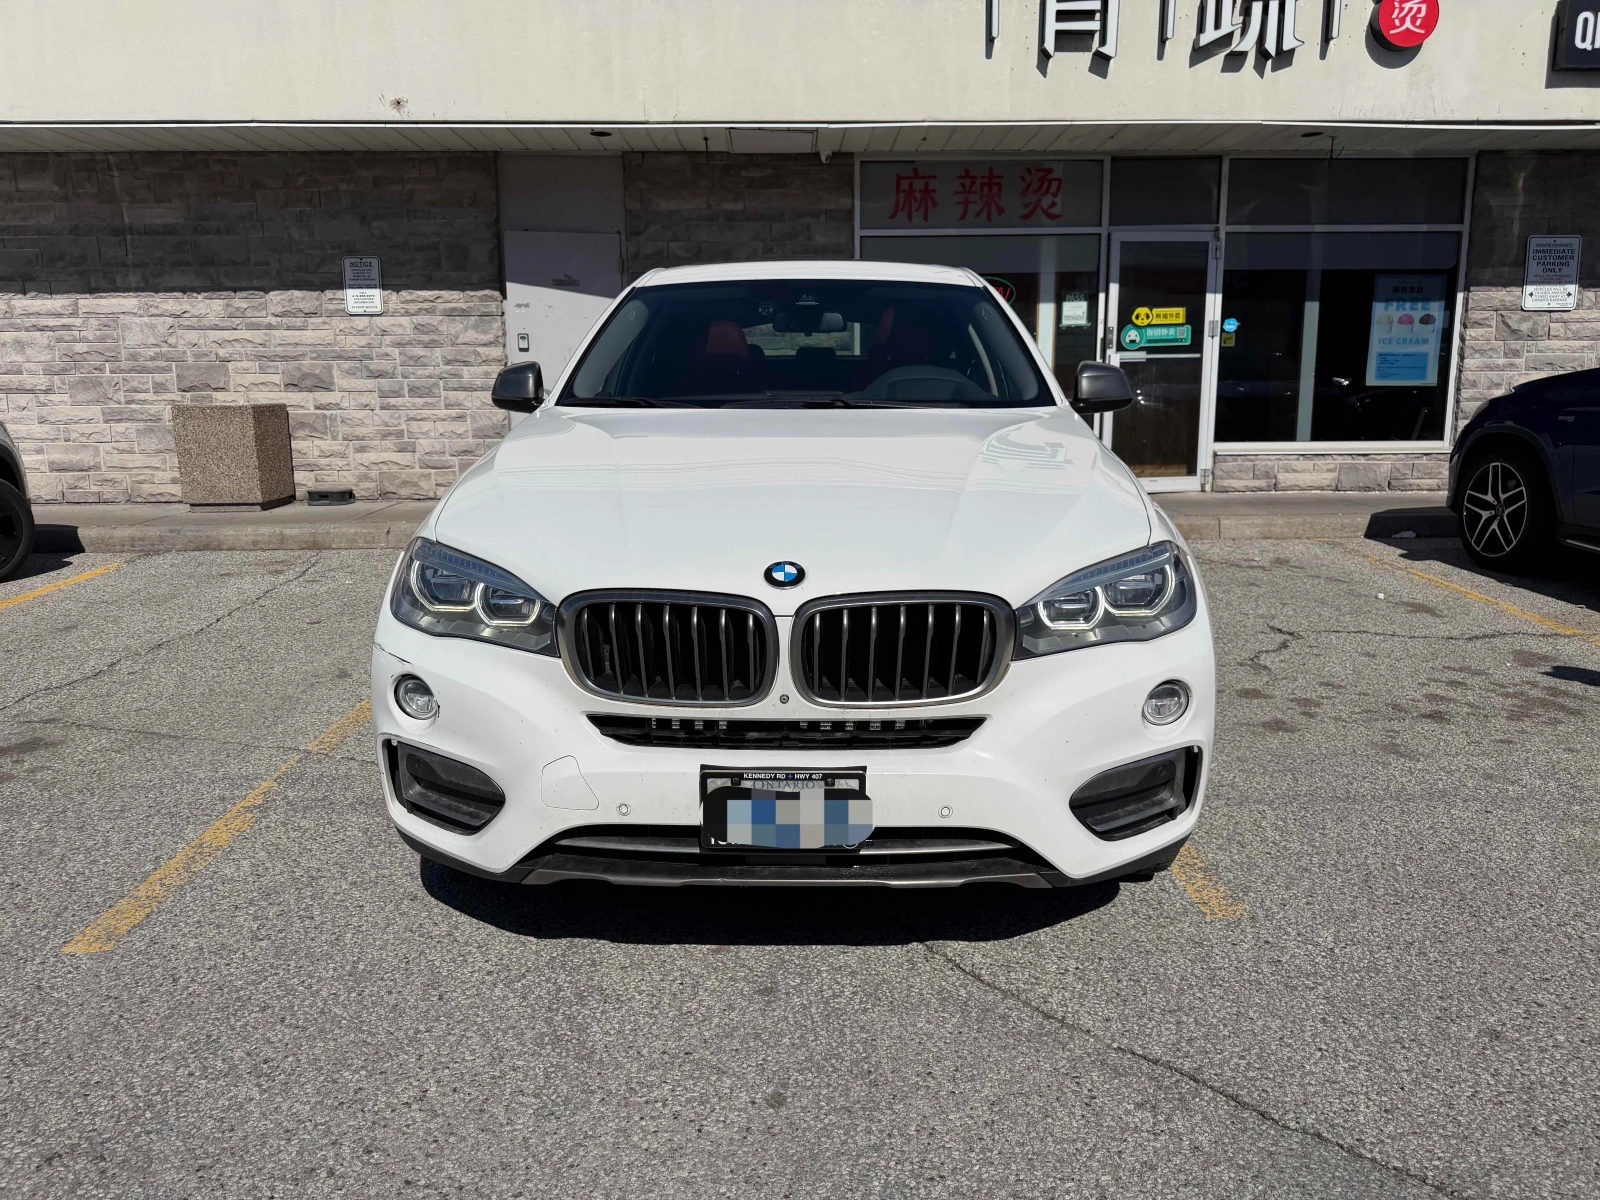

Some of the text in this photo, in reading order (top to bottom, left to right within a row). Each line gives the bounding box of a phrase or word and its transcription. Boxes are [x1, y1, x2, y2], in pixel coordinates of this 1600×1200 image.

[1389, 0, 1427, 34] 烫
[887, 166, 1063, 223] 麻辣烫
[1384, 298, 1431, 311] FREE
[1378, 337, 1429, 345] ICE CREAM
[752, 780, 815, 790] ONTARIO
